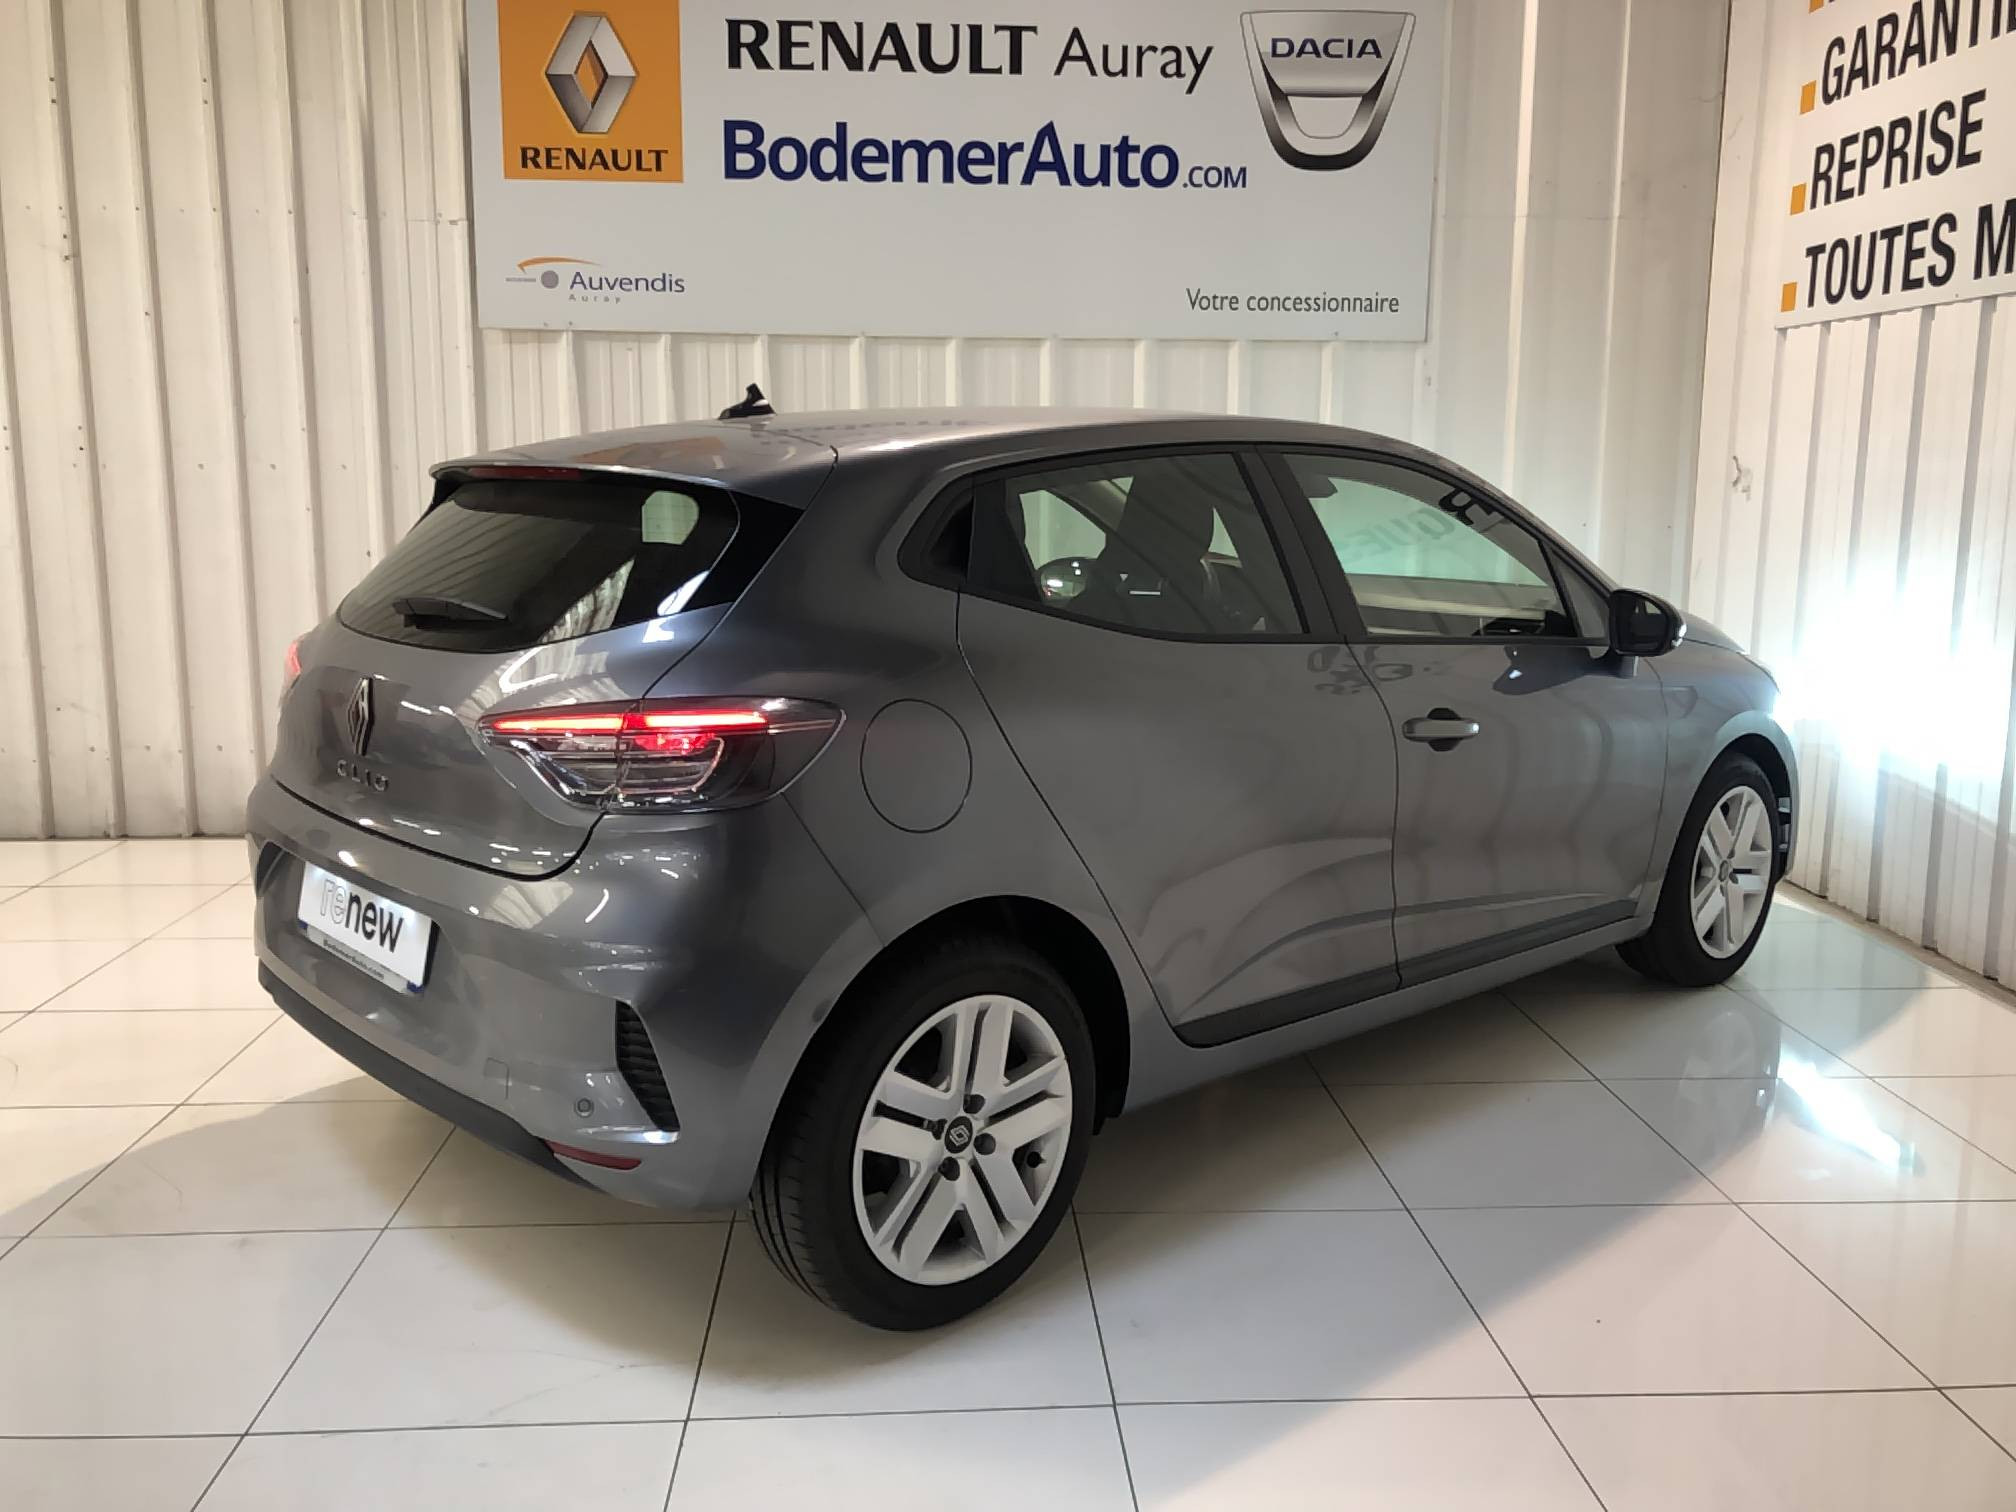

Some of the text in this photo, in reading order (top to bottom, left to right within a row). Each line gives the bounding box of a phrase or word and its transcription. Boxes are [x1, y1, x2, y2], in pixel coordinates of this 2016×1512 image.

[724, 18, 1214, 95] RENAULT Auray
[1270, 37, 1383, 60] DACIA
[519, 146, 669, 172] RENAULT
[1809, 88, 1987, 210] REPRISE
[1805, 212, 1958, 308] TOUTES
[569, 270, 686, 294] Auvendis
[1186, 288, 1400, 313] Votre concessionnaire
[336, 759, 390, 792] CLIO
[319, 878, 404, 953] renew
